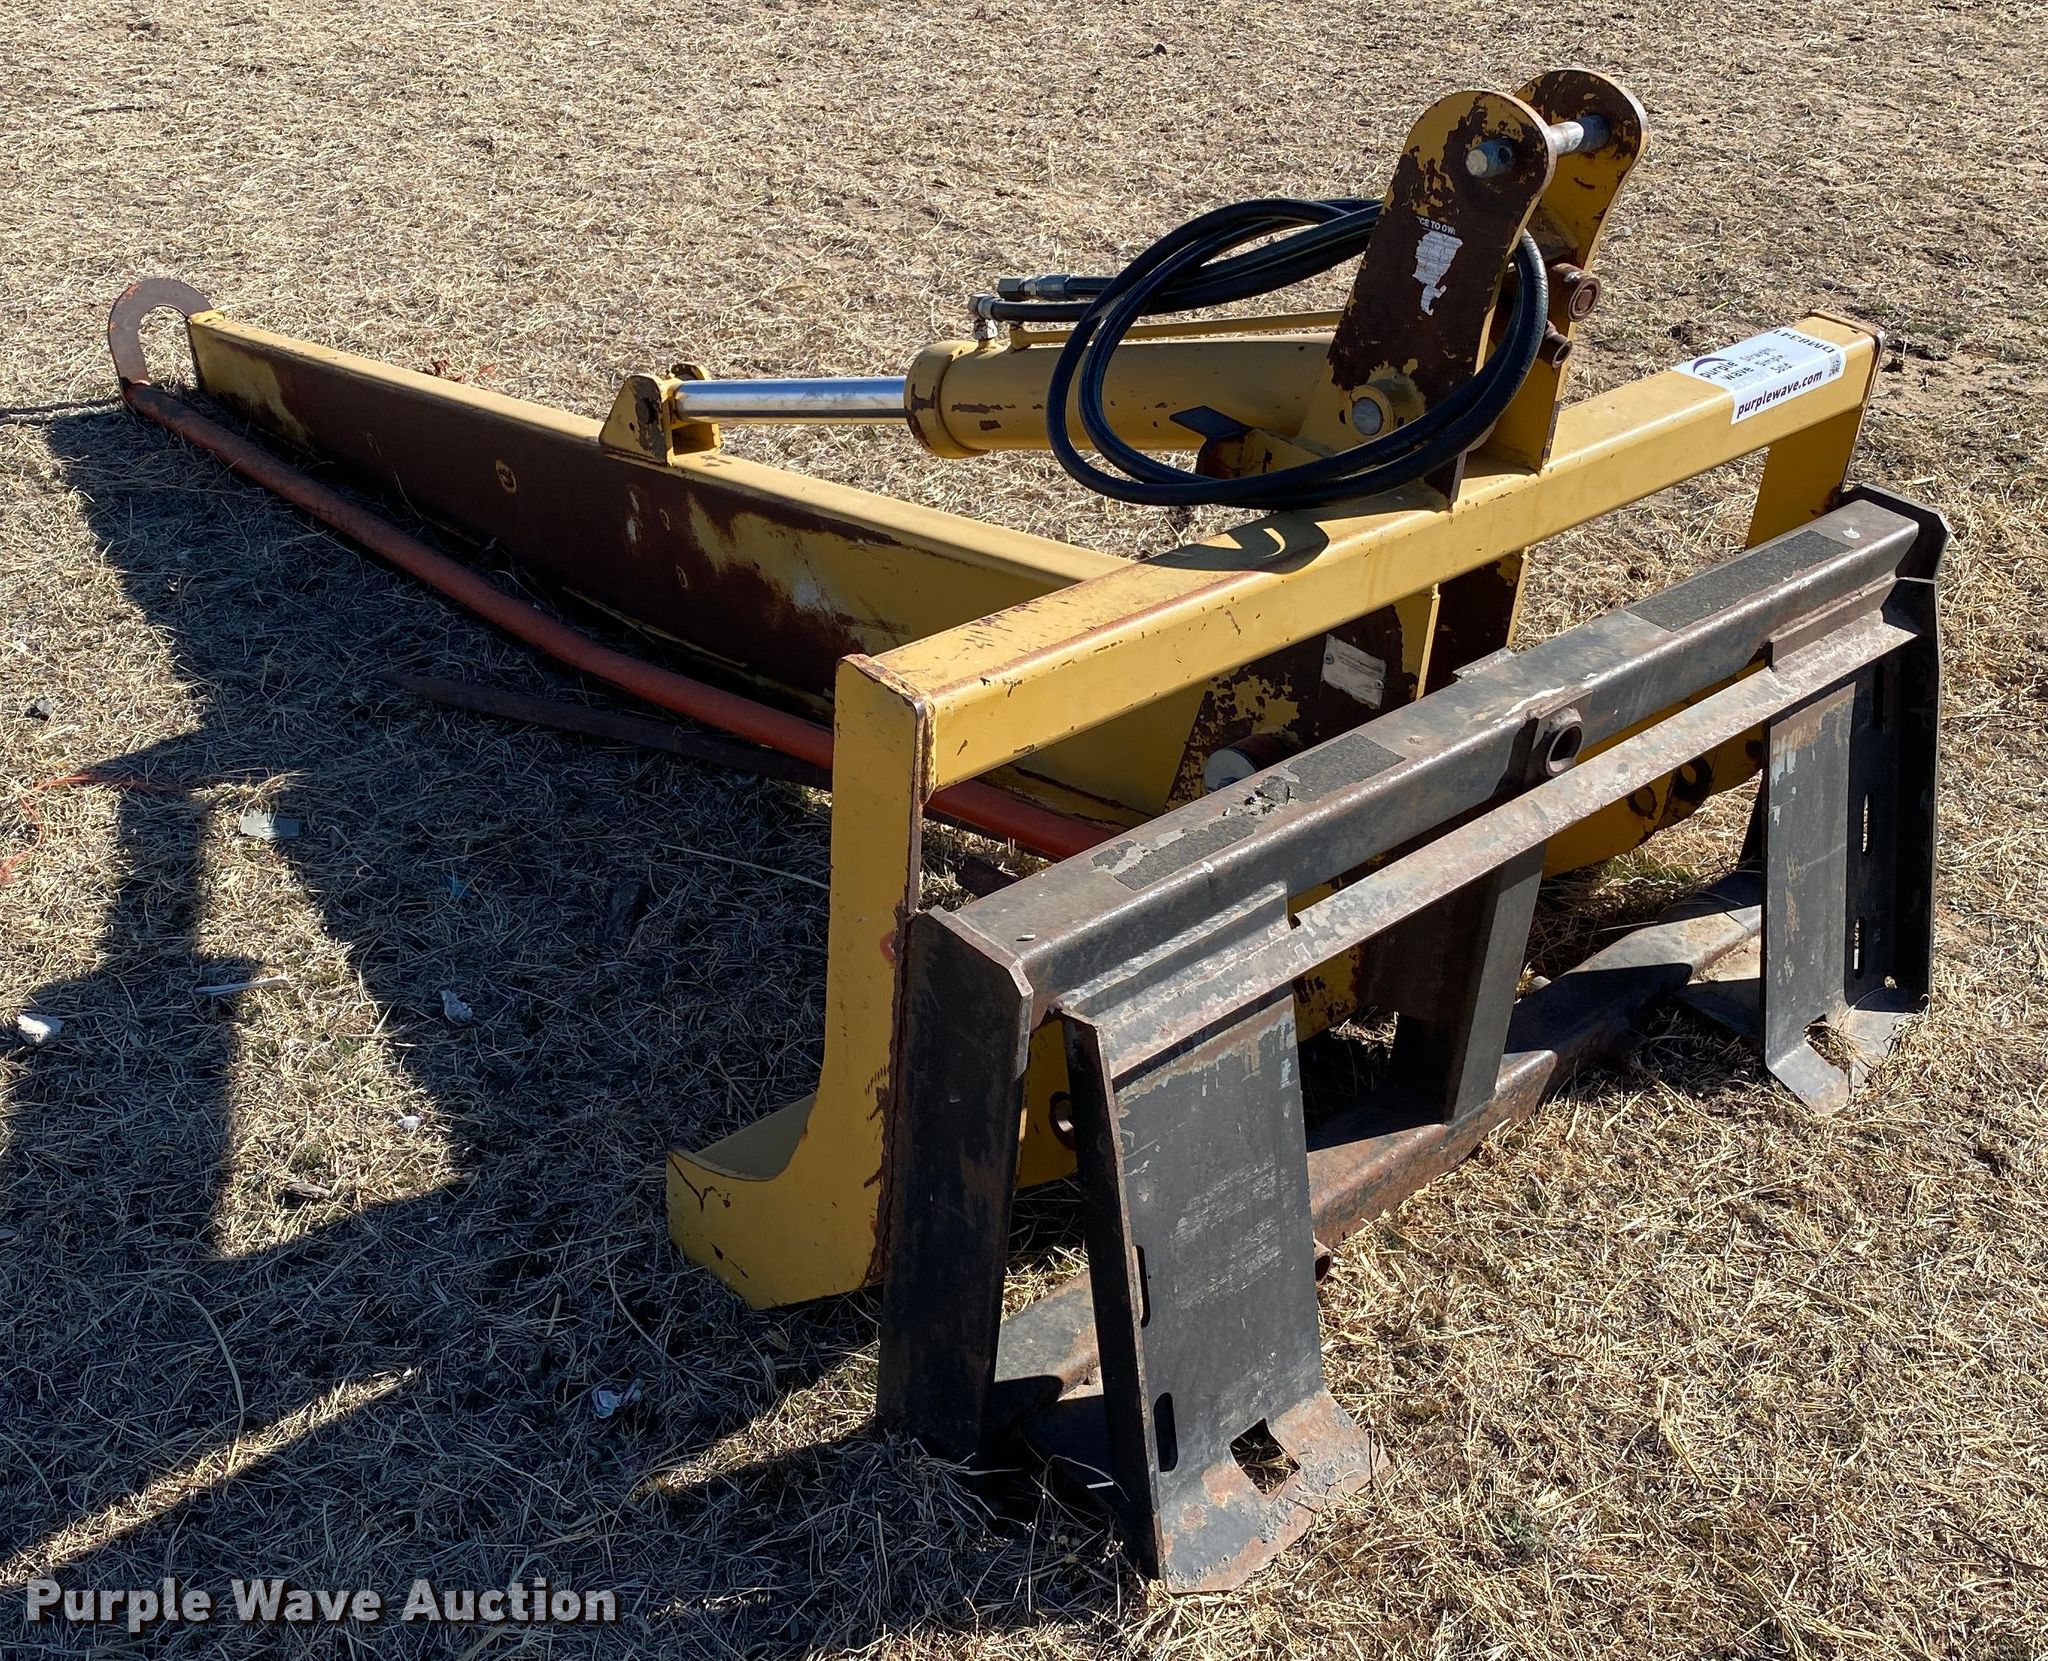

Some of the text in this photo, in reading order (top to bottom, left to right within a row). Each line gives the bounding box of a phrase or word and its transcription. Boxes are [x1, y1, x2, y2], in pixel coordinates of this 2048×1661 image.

[1431, 220, 1441, 230] TO
[1700, 360, 1738, 379] purple
[1722, 367, 1755, 381] wave
[1736, 371, 1823, 419] purplewave.com
